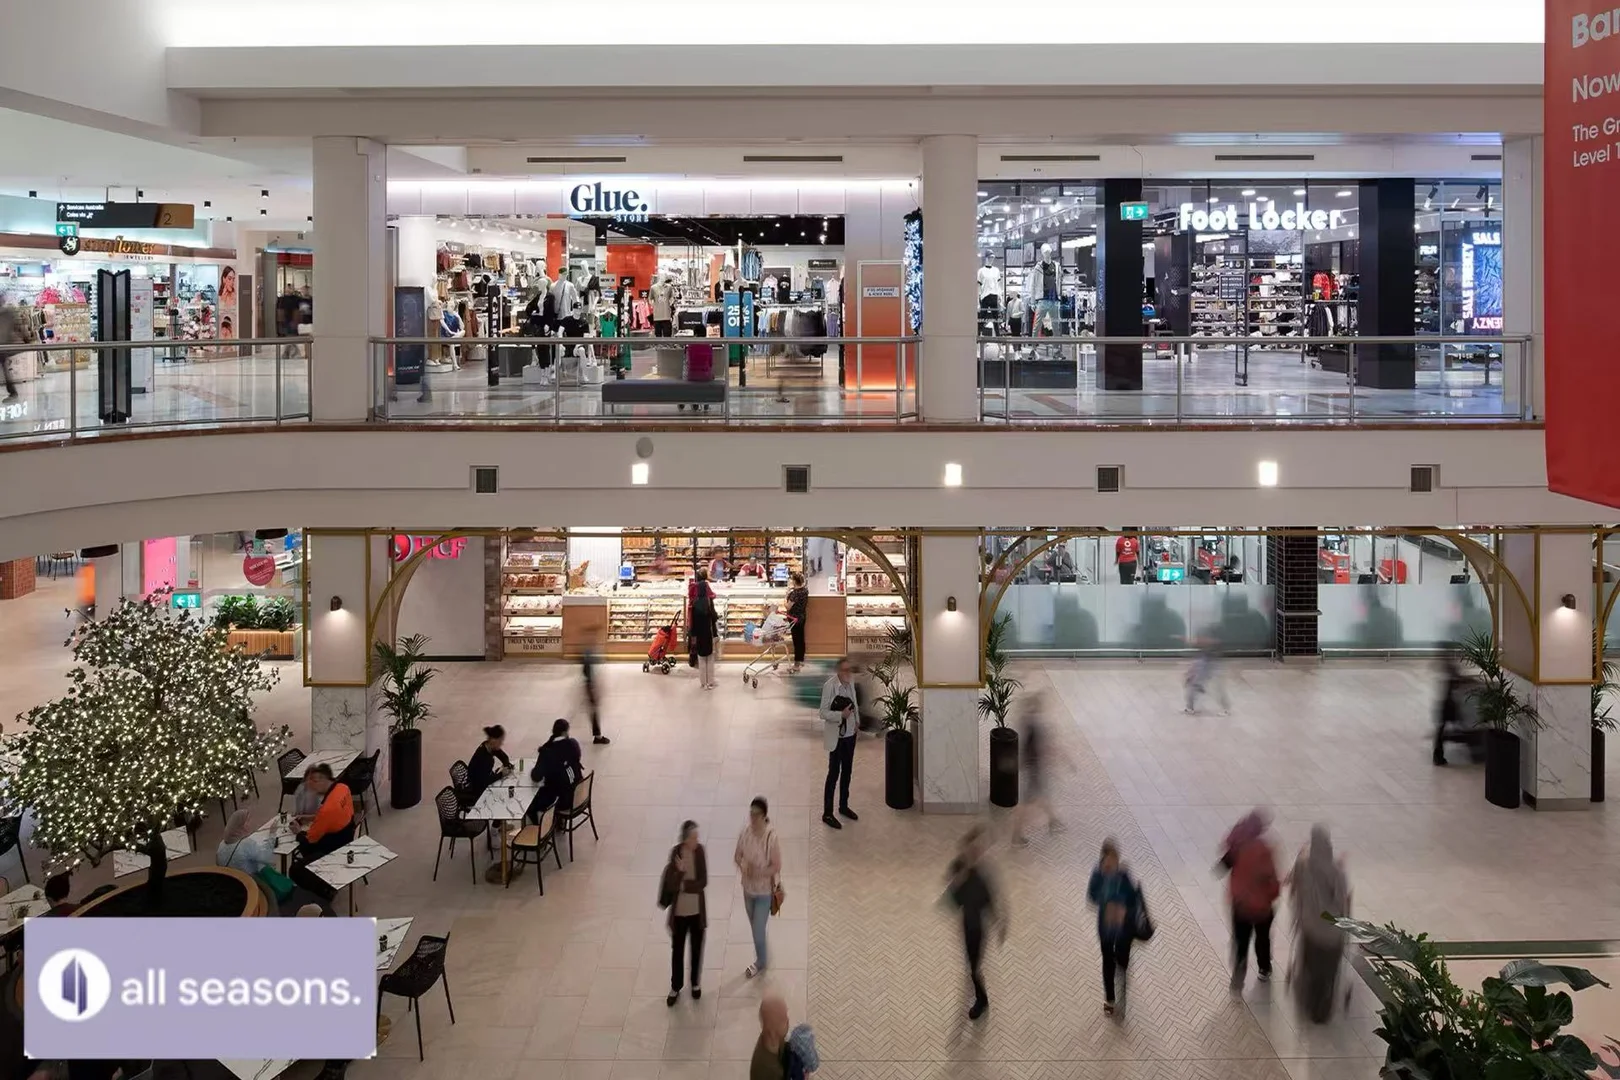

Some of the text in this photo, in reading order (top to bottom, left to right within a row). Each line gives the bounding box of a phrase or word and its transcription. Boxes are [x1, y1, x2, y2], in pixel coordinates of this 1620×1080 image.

[1572, 124, 1599, 142] The
[1573, 144, 1611, 168] Level
[570, 181, 648, 212] Glue.
[163, 213, 172, 225] 2
[1180, 201, 1341, 230] Foot Locker
[1472, 317, 1503, 329] ENZY
